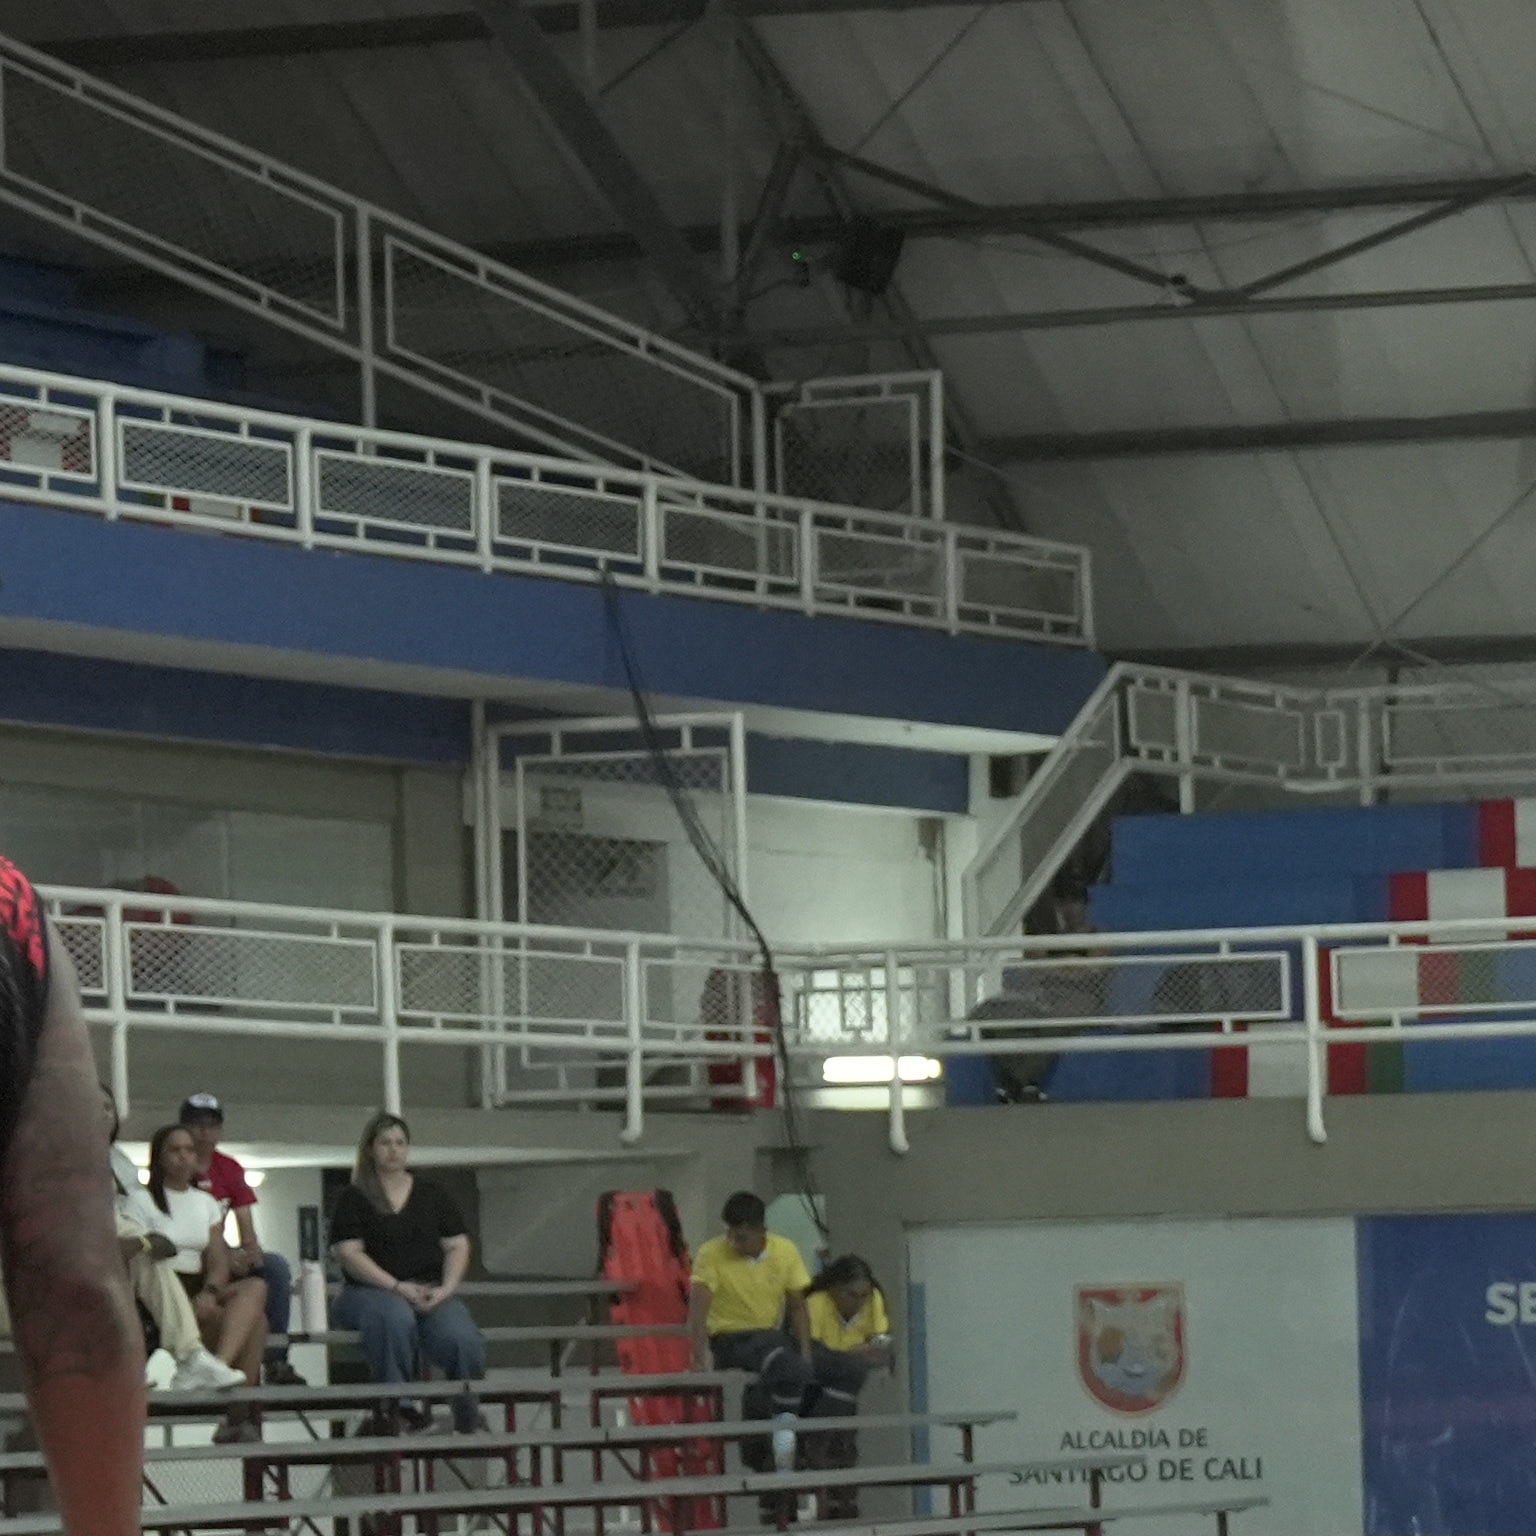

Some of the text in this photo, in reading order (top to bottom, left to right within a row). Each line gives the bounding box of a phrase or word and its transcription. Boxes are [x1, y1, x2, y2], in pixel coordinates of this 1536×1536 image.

[1179, 1427, 1208, 1448] DE
[1159, 1457, 1194, 1481] DE
[1203, 1456, 1263, 1480] CALI
